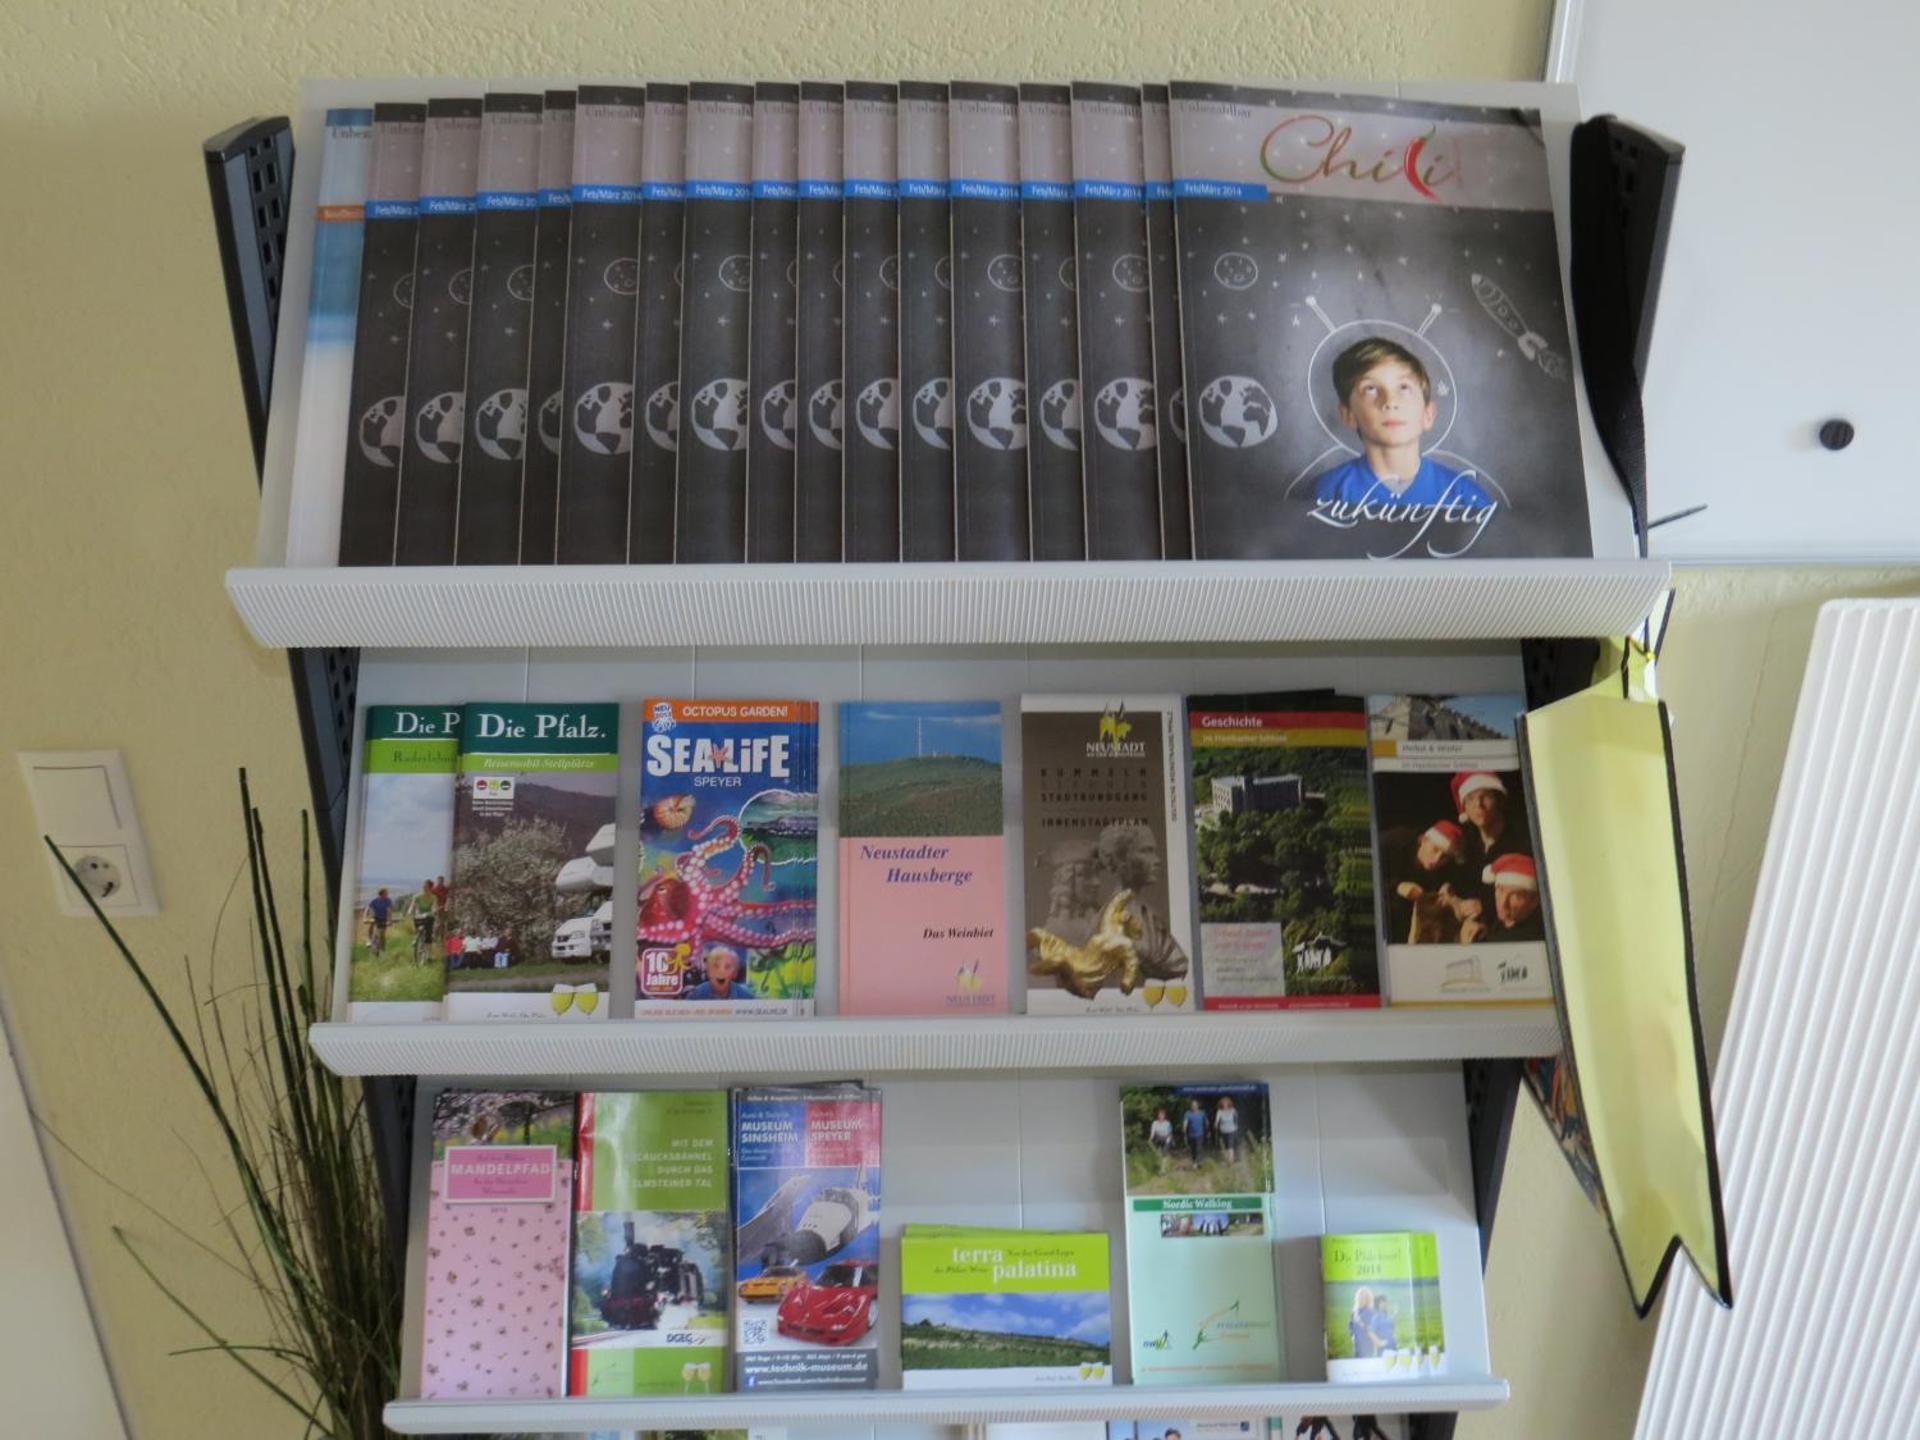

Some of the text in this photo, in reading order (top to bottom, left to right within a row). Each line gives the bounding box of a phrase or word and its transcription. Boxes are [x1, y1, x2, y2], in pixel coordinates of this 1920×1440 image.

[1307, 470, 1498, 560] zukünftig
[682, 705, 737, 717] OCTOPUS
[394, 712, 436, 734] Die
[477, 713, 606, 739] Die Pfalz.
[1202, 716, 1263, 728] Geschichte
[694, 776, 742, 787] SPEYER
[886, 867, 973, 886] Hausberge
[923, 927, 994, 939] Das Weinbiet
[647, 973, 679, 986] Jahre
[741, 1121, 793, 1132] MUSEUM
[811, 1119, 863, 1131] MUSEUM
[741, 1133, 799, 1144] SINSHEIM
[810, 1131, 851, 1142] SPEYER
[450, 1163, 550, 1175] MANDELPFAD
[1162, 1199, 1233, 1209] Nordic Walking
[952, 1247, 1003, 1263] terra
[992, 1260, 1077, 1284] palatina
[745, 1362, 868, 1374] www.technik-museum.de
